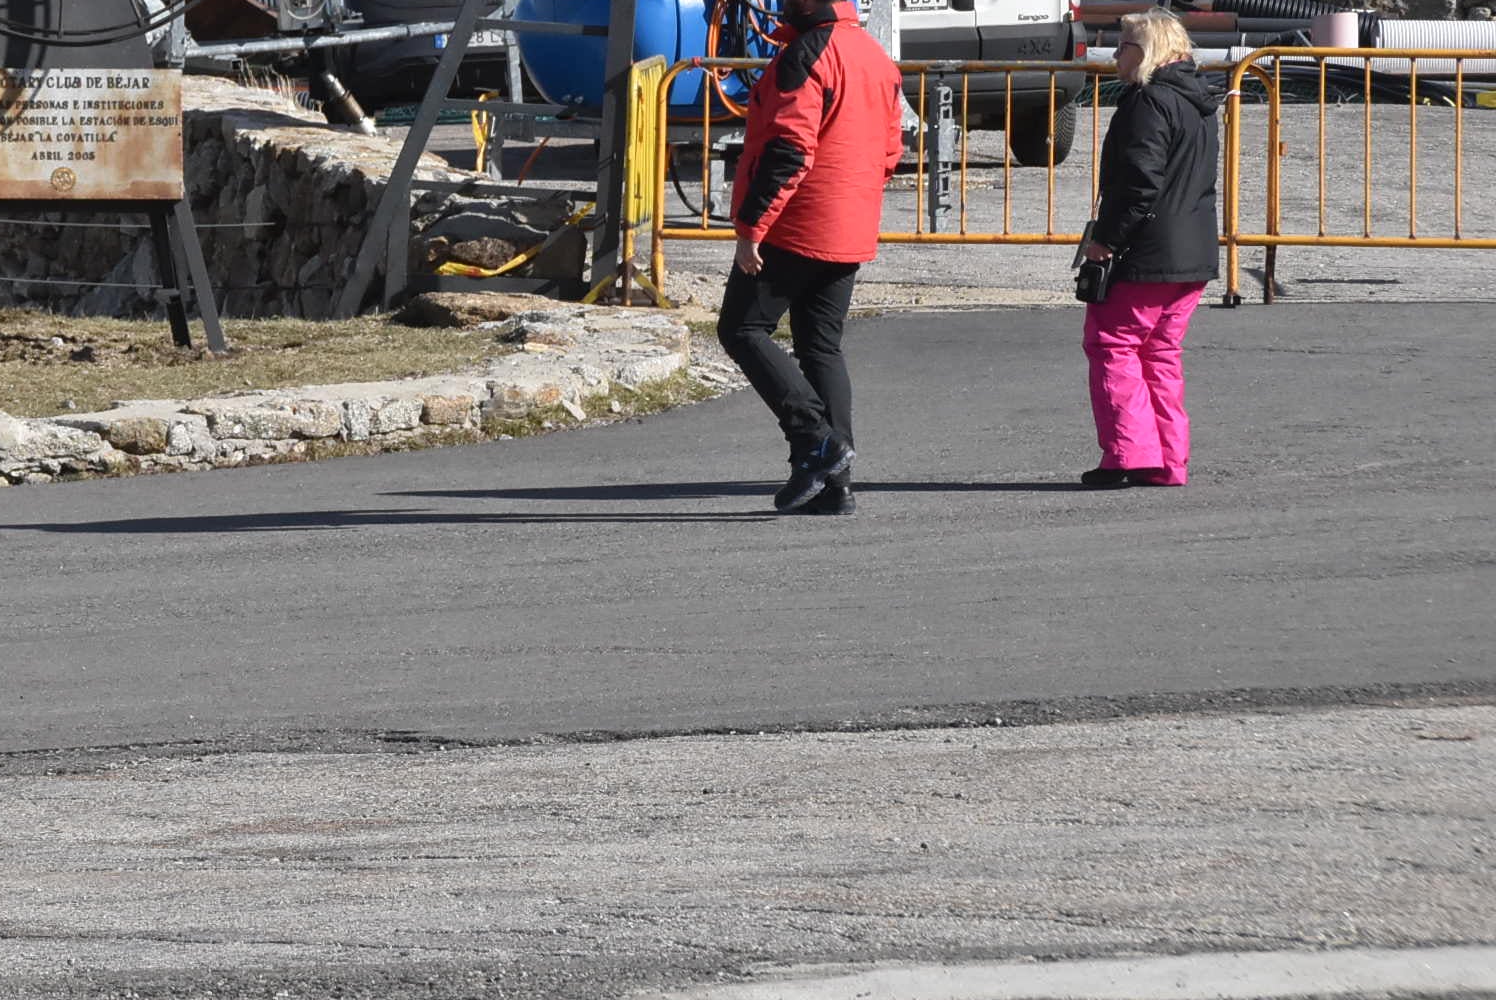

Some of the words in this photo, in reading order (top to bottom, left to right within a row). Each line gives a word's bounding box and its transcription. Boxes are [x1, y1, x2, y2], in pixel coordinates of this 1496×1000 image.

[46, 76, 82, 89] CLUB
[86, 76, 103, 89] DE
[106, 73, 151, 89] BÉJAR
[15, 100, 69, 110] PERSONAS
[73, 100, 80, 110] E
[83, 100, 164, 110] INSTITUCIONES
[15, 116, 58, 126] POSIBLE
[62, 116, 75, 126] LA
[79, 114, 130, 126] ESTACIÓN
[133, 116, 146, 126] DE
[31, 152, 64, 161] ABRIL
[67, 152, 96, 161] 2005
